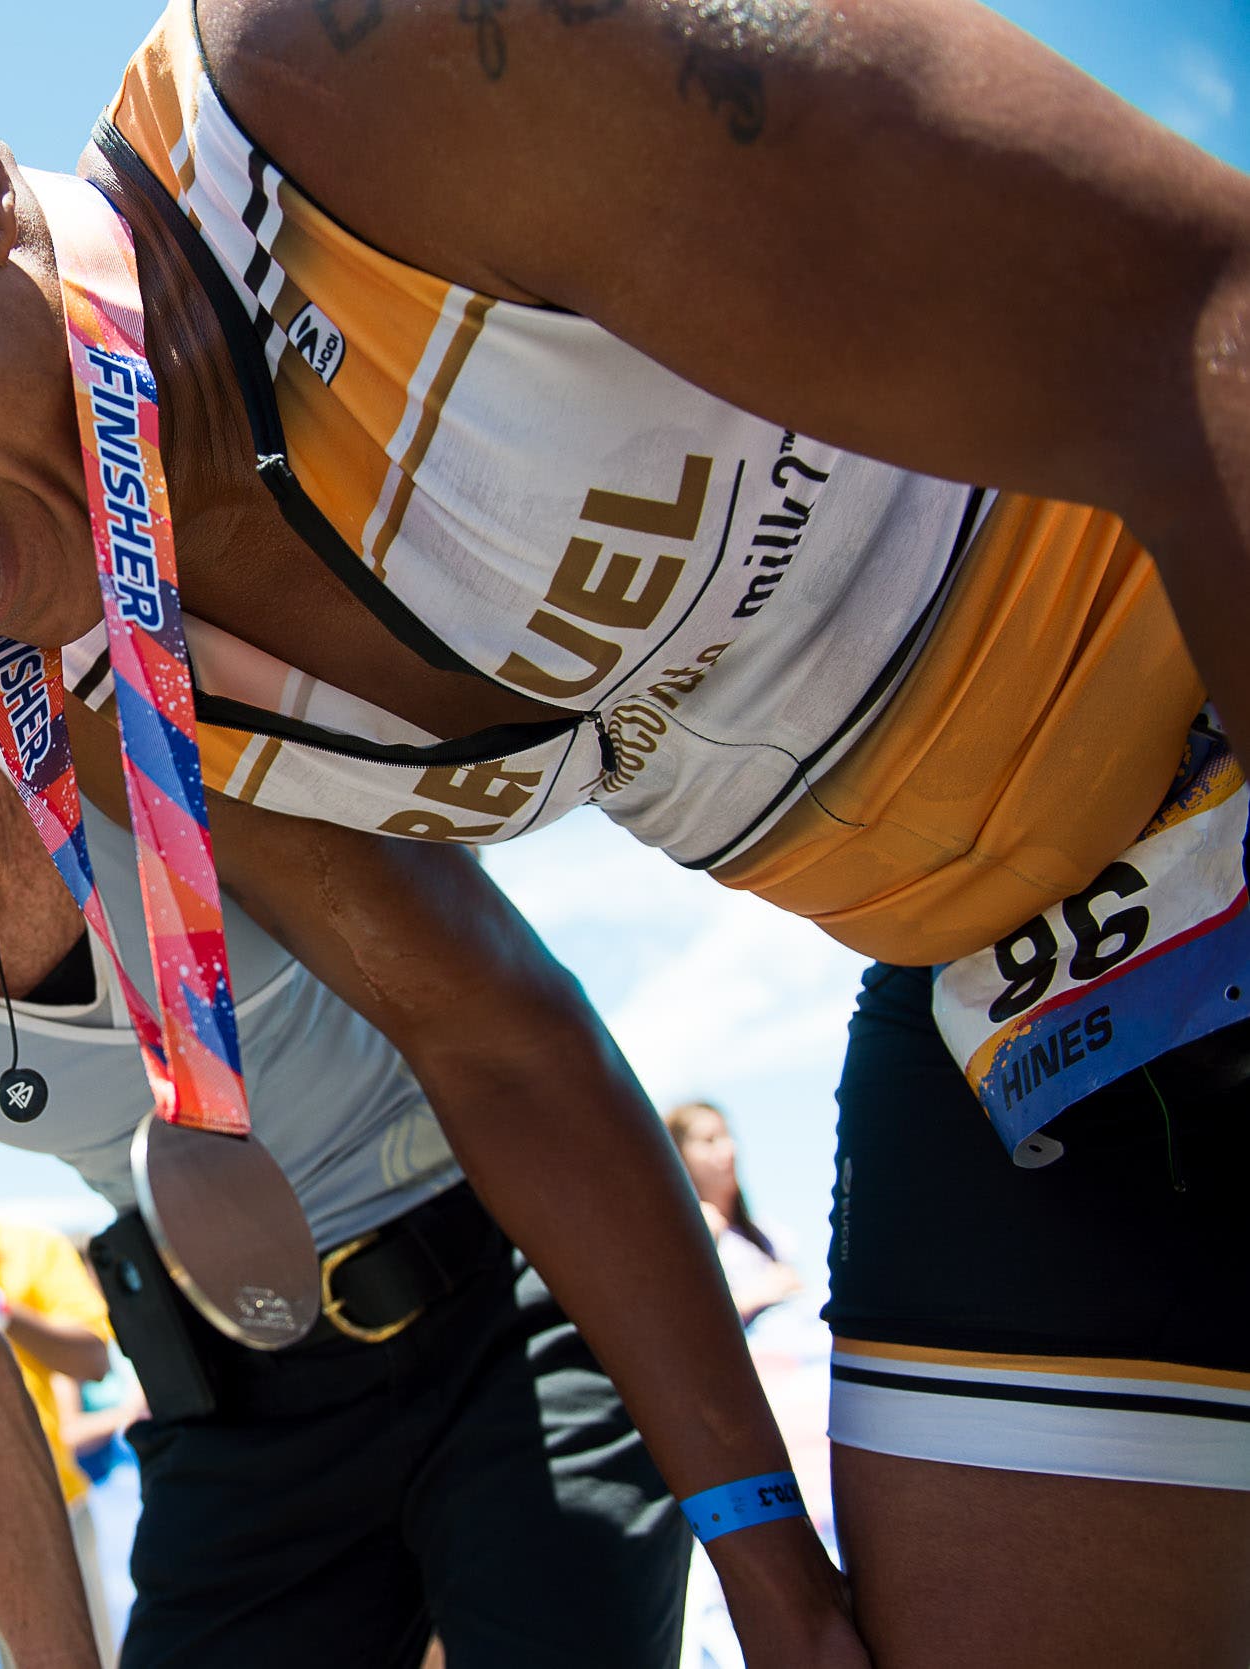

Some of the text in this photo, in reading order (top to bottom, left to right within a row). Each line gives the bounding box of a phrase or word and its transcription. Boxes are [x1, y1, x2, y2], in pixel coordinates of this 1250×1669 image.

[315, 332, 339, 379] UGOI
[85, 348, 164, 632] FINISHER
[989, 861, 1149, 1023] 96
[1001, 1006, 1113, 1111] HINES
